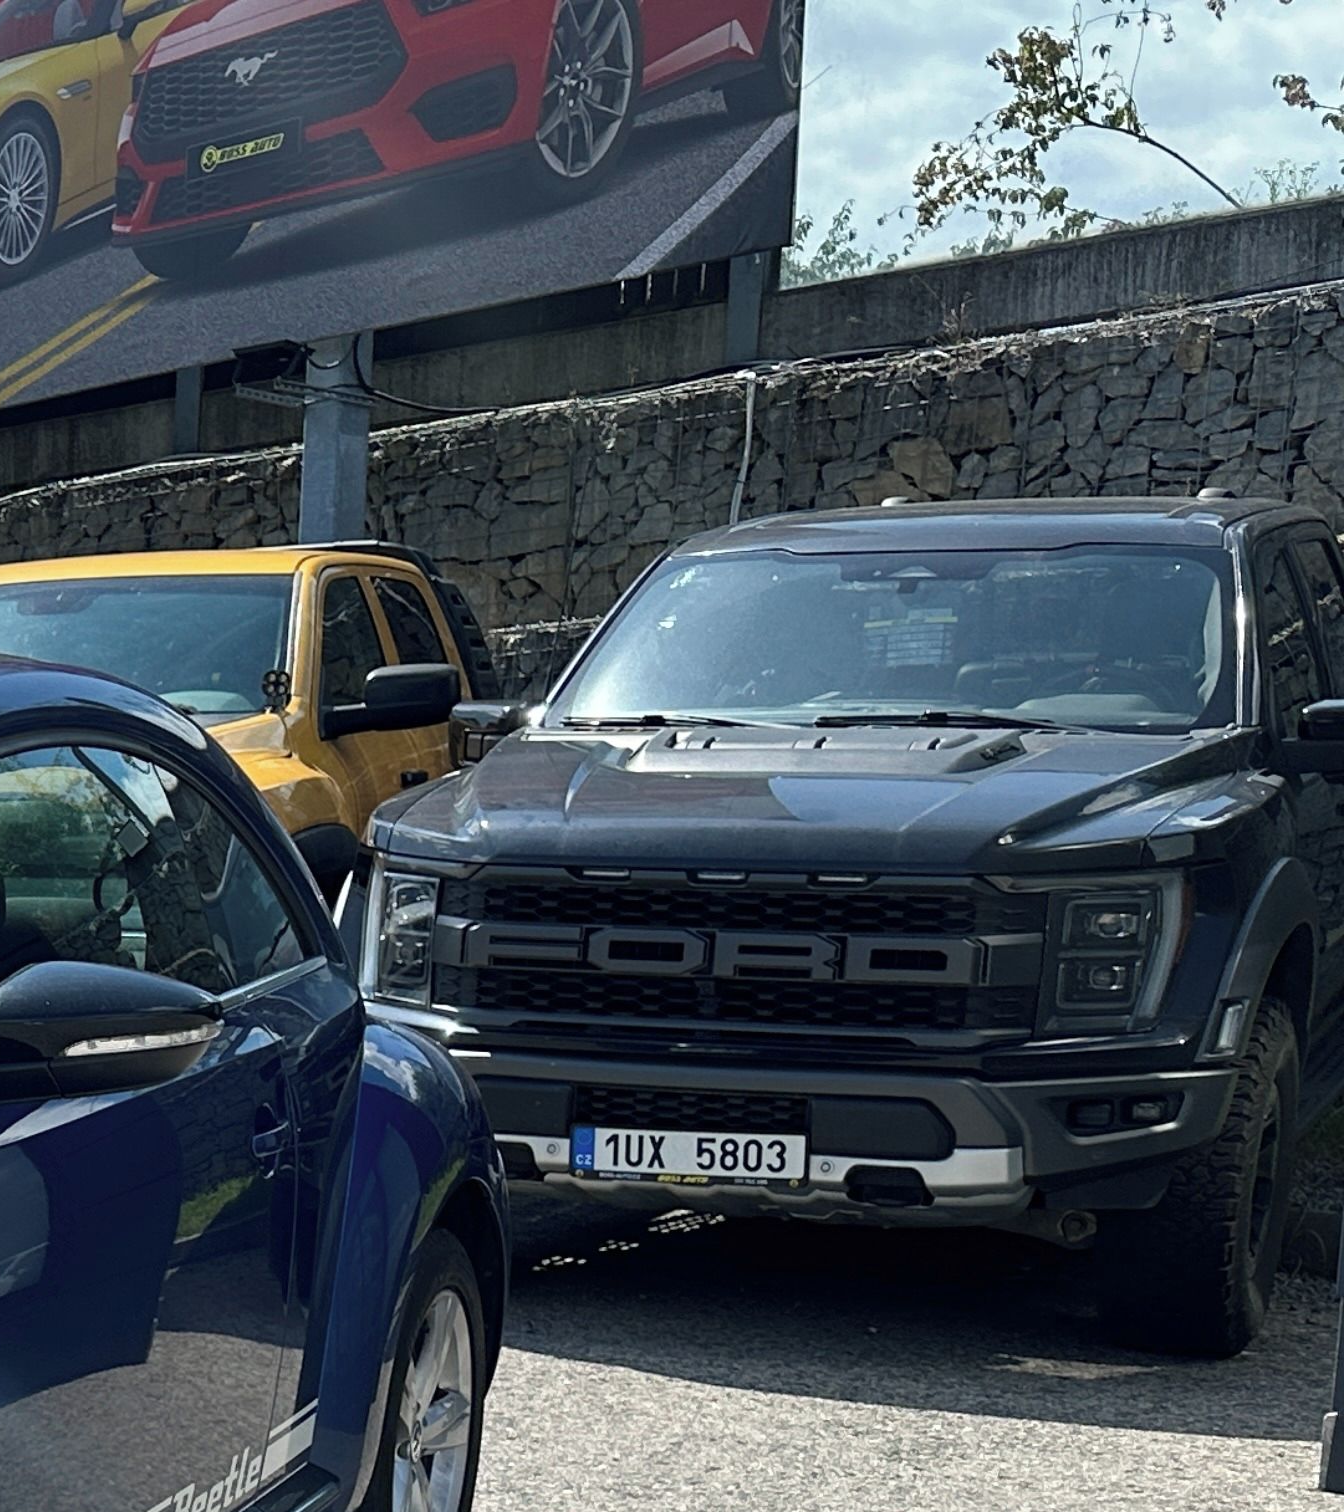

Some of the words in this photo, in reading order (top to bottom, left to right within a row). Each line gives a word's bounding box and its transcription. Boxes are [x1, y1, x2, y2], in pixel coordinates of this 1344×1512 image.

[466, 921, 976, 985] FORD
[575, 1153, 592, 1166] CZ
[605, 1133, 666, 1169] 1UX
[696, 1137, 787, 1173] 5803
